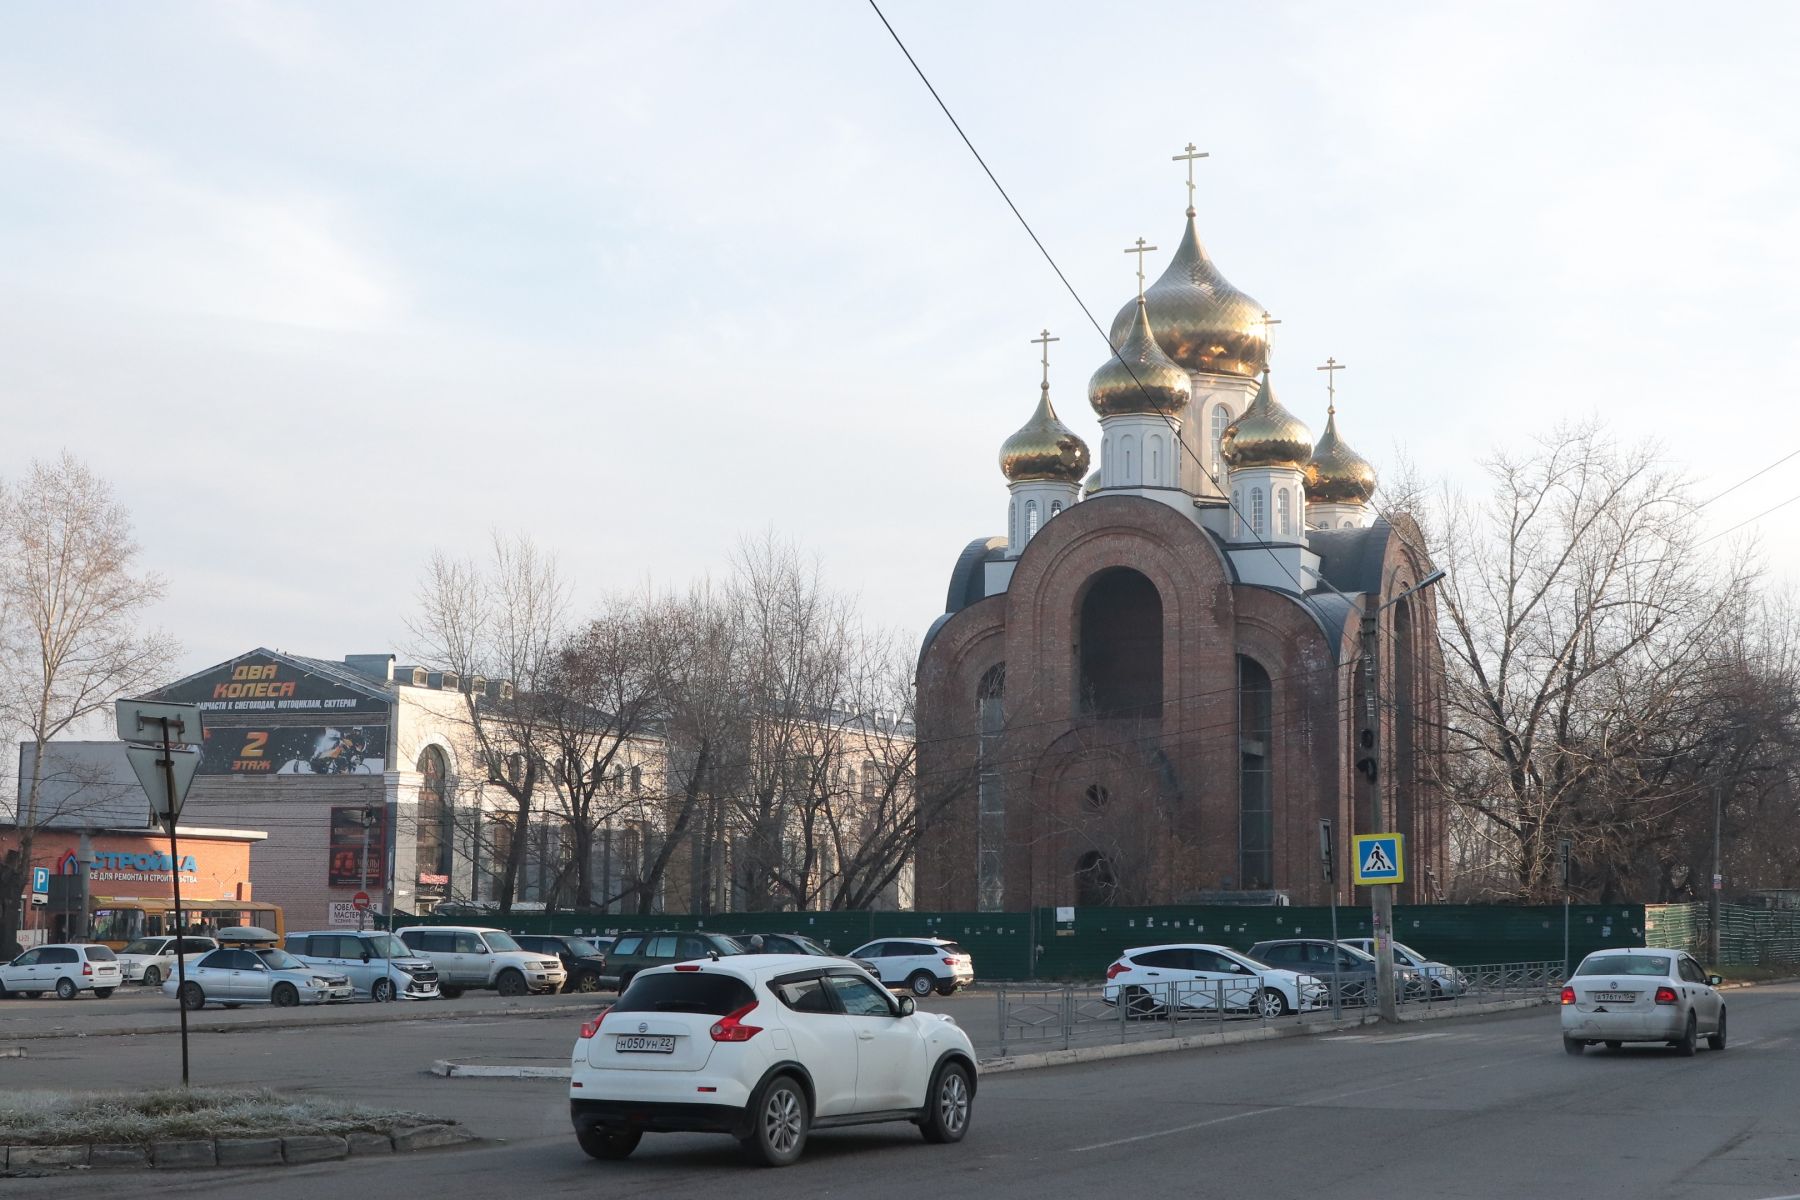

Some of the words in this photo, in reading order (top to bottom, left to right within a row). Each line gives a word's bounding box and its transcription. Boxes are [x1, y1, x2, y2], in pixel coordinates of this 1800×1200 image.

[232, 664, 278, 680] ДВА
[213, 681, 296, 698] КОЛЕСА
[228, 701, 233, 710] К
[234, 700, 276, 710] СНЕГОХОДАМ,
[278, 699, 322, 709] МОТОЦИКЛАМ,
[323, 699, 357, 708] СКУТЕРАМ
[240, 732, 269, 756] 2
[231, 760, 271, 770] ЭТАЖ
[37, 871, 46, 889] P
[89, 871, 99, 880] СЁ
[99, 872, 113, 881] ДЛЯ
[114, 873, 143, 882] РЕМОНТА
[143, 874, 149, 882] И
[334, 903, 377, 911] ЮВЕЛАЯ
[620, 1038, 657, 1049] Н050УН
[660, 1038, 671, 1047] 22
